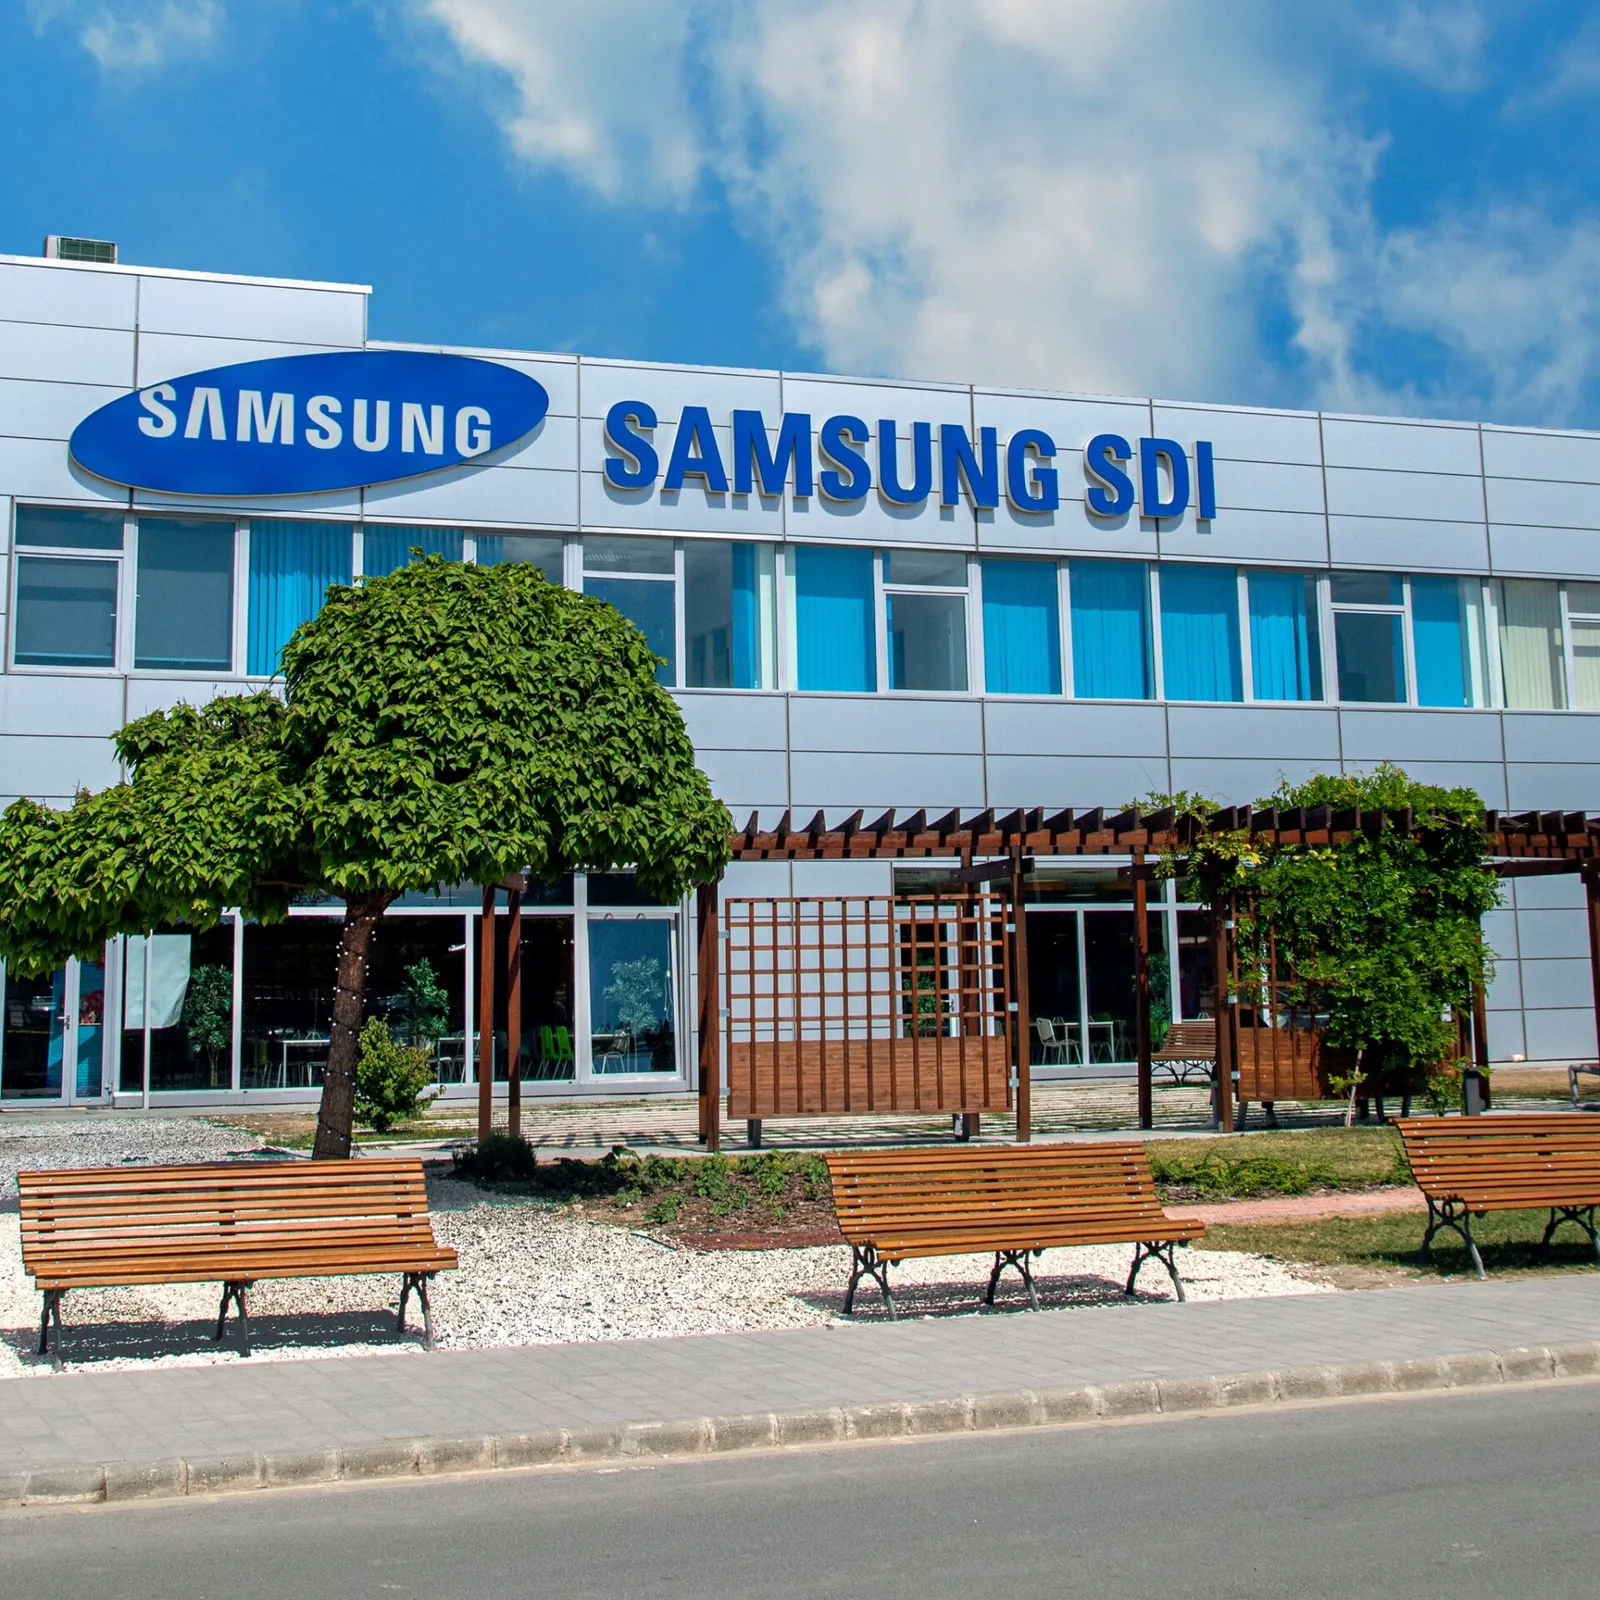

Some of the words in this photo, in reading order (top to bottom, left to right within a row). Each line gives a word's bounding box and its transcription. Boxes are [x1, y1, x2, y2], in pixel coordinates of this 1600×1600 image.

[137, 383, 491, 458] SAMSUNG
[604, 400, 1059, 513] SAMSUNG
[1085, 433, 1217, 520] SDI
